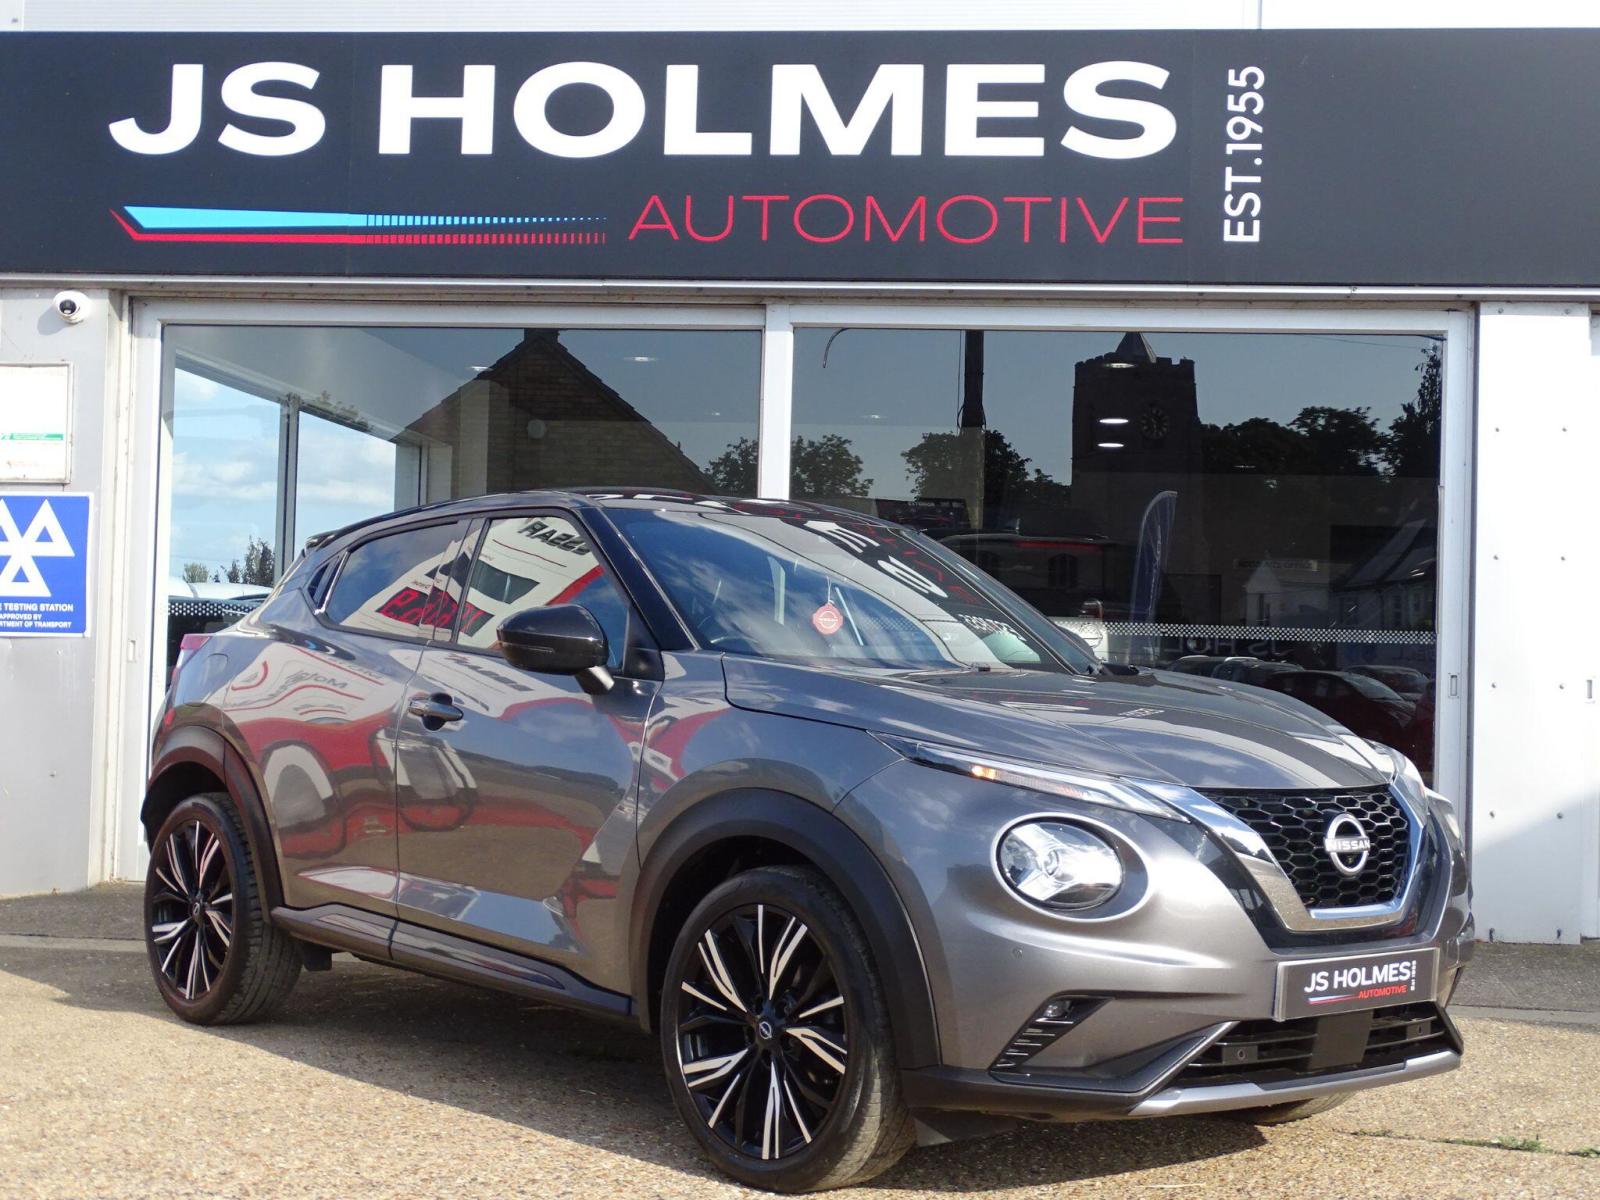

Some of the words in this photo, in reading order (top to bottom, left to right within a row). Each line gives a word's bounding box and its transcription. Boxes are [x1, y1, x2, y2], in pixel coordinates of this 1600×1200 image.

[108, 61, 326, 157] JS
[378, 61, 1177, 160] HOLMES
[1223, 65, 1265, 243] EST.1955
[628, 193, 1185, 245] AUTOMOTIVE
[4, 603, 38, 612] TESTING
[39, 603, 74, 612] STATION
[33, 613, 42, 621] BY
[34, 621, 72, 629] TRANSPORT
[1326, 838, 1371, 851] NISSAN
[1304, 971, 1330, 993] JS
[1333, 961, 1411, 990] HOLMES
[1358, 985, 1407, 999] AUTOMOTIVE
